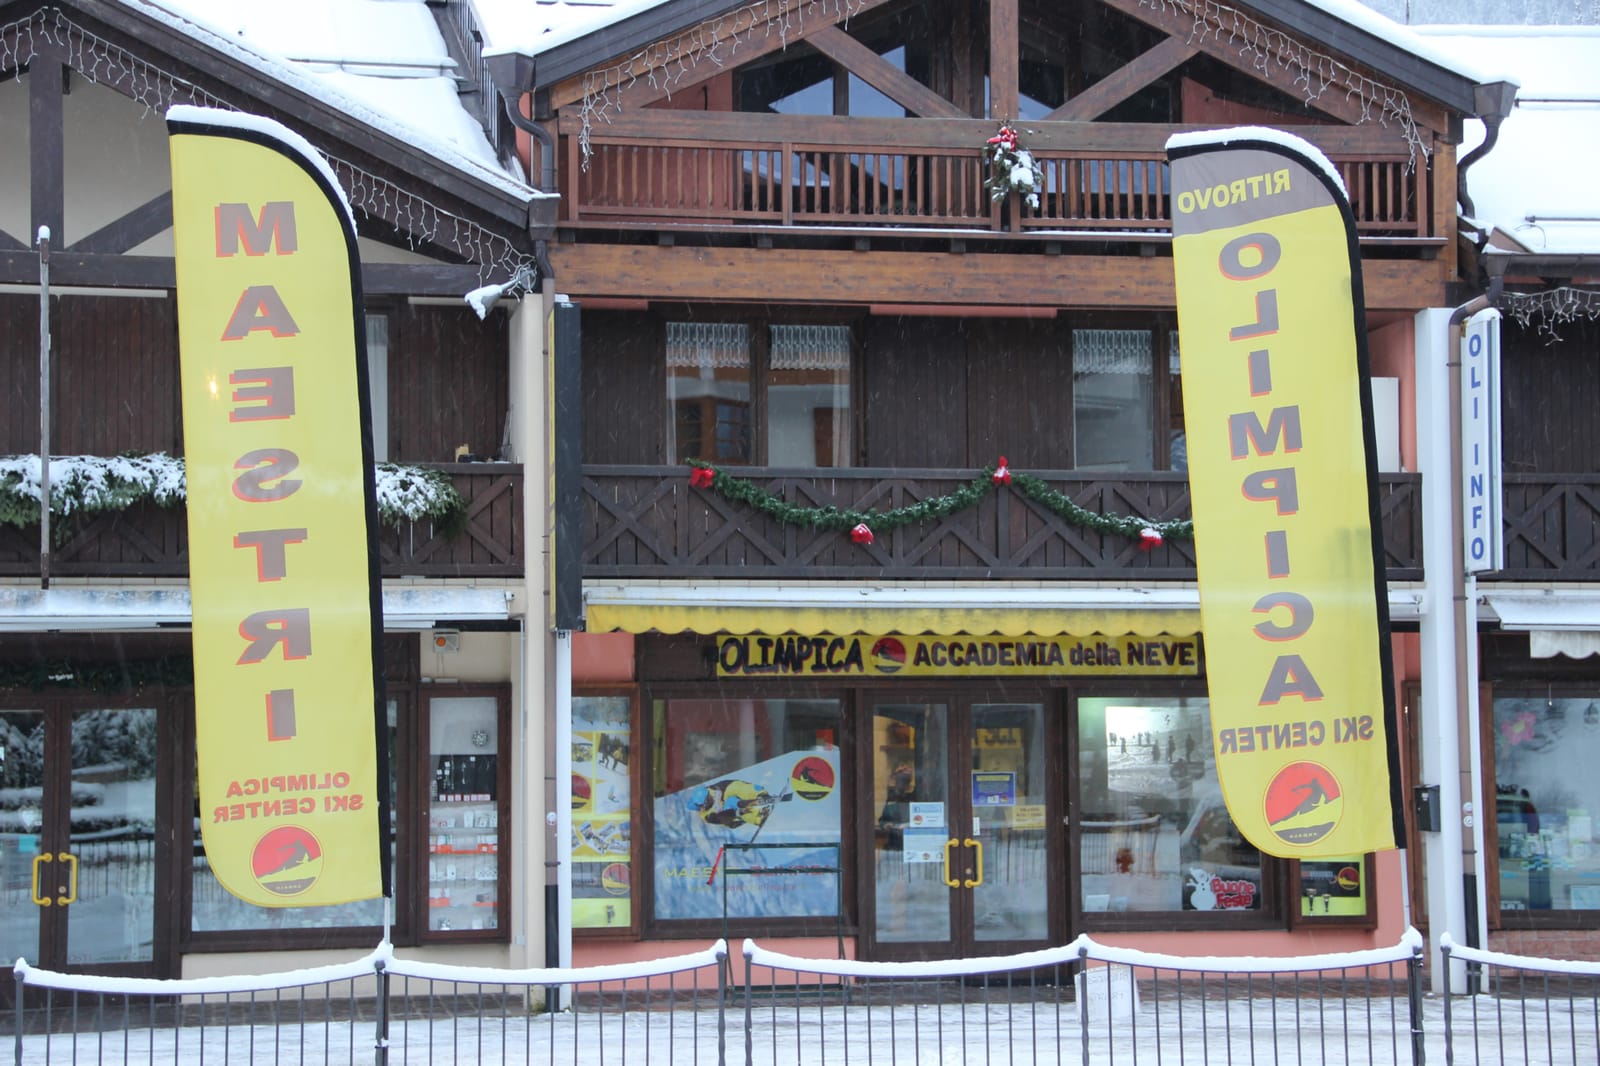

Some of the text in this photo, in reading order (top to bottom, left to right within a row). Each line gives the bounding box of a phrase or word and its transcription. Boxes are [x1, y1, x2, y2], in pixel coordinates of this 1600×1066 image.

[1469, 334, 1485, 560] OLI INFO
[719, 637, 1195, 673] OLIMPICA ACCADEMIA della NEVE
[1211, 878, 1255, 895] Buone
[1216, 893, 1252, 908] Feste
